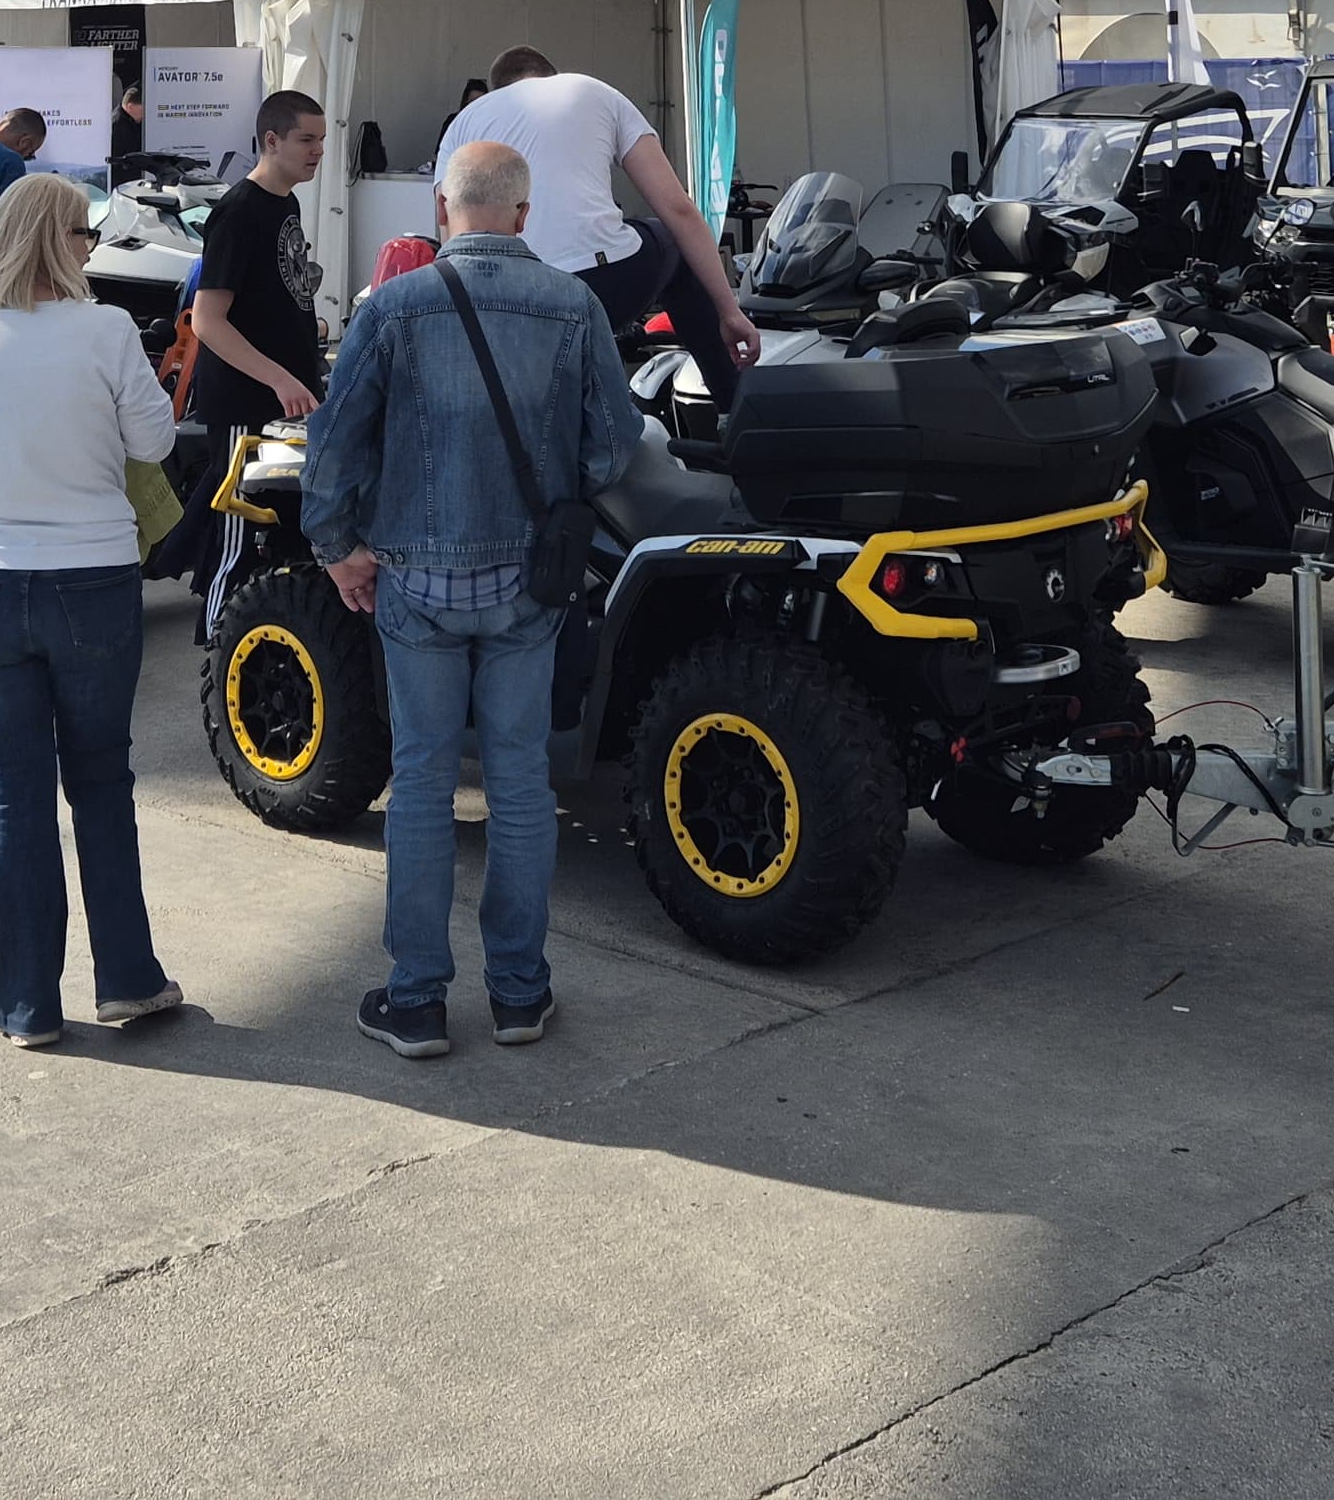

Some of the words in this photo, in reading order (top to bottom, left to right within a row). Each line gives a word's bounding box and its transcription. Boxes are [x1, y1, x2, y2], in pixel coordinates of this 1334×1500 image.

[87, 29, 140, 41] FARTHER
[158, 72, 198, 82] AVATOR
[204, 72, 224, 82] 7.5e
[685, 540, 786, 555] can-am
